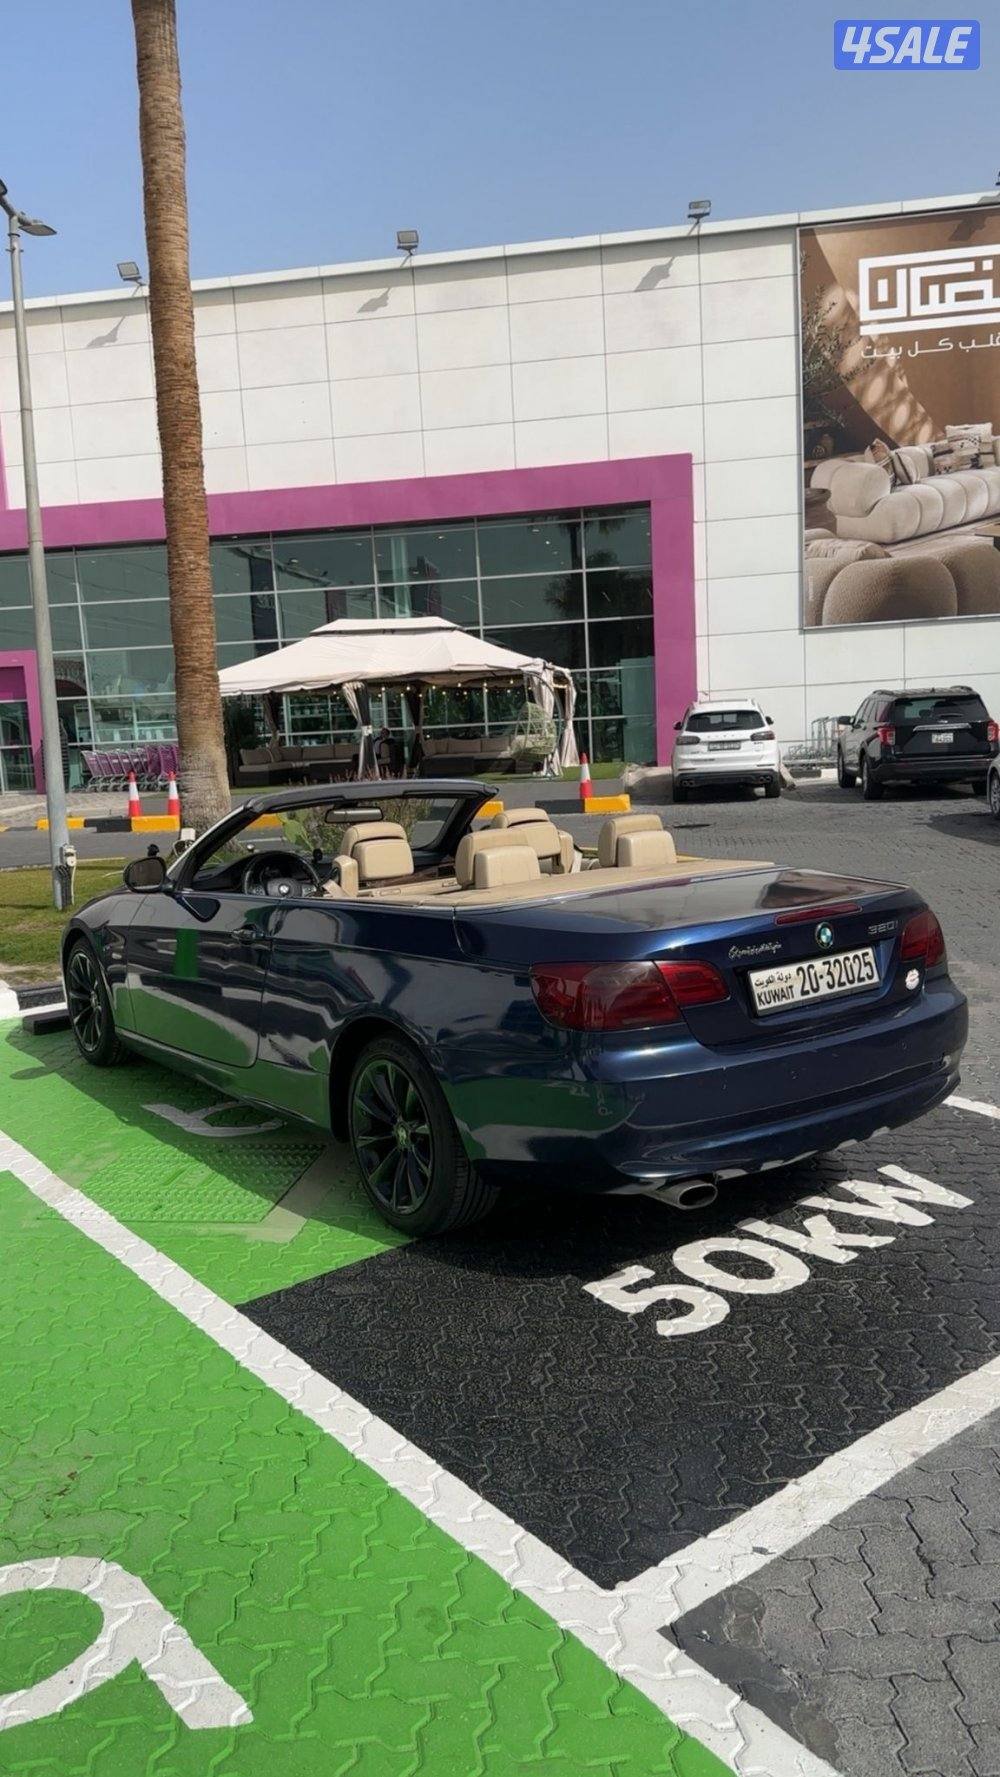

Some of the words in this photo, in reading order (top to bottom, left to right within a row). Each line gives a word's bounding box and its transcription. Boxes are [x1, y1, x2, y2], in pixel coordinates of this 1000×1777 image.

[861, 345, 903, 359] بيت
[907, 338, 954, 357] كل
[754, 974, 775, 989] الكويت
[776, 971, 792, 984] دولة
[796, 951, 875, 997] 20-32025
[756, 985, 795, 1007] KUWAIT
